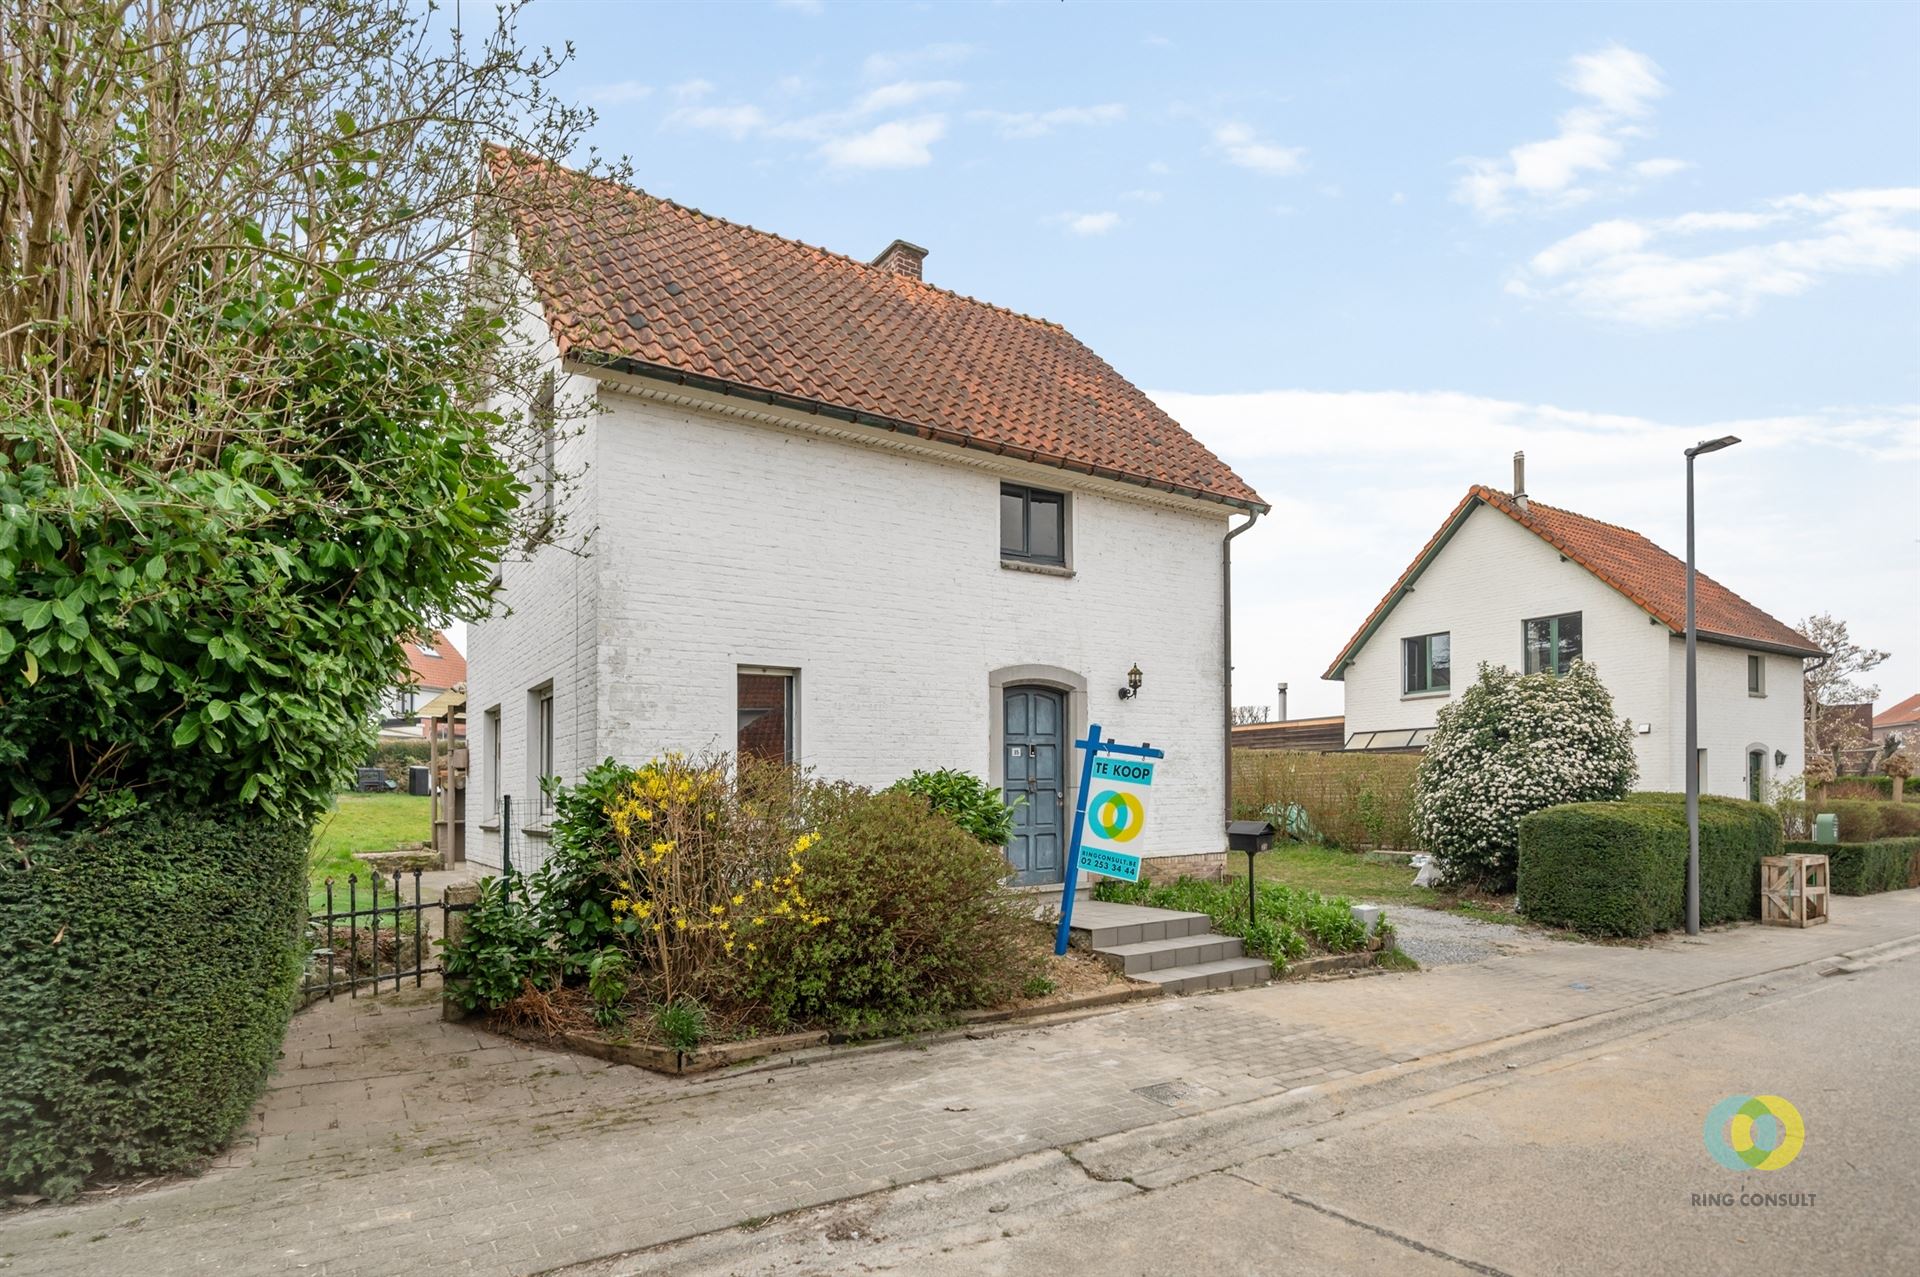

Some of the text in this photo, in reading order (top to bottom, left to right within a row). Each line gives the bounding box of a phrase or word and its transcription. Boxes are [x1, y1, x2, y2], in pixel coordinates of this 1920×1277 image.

[1096, 762, 1150, 779] TE KOOP
[1081, 857, 1135, 876] 02 253 34 44
[1082, 850, 1136, 867] RINGCONSULT.BE
